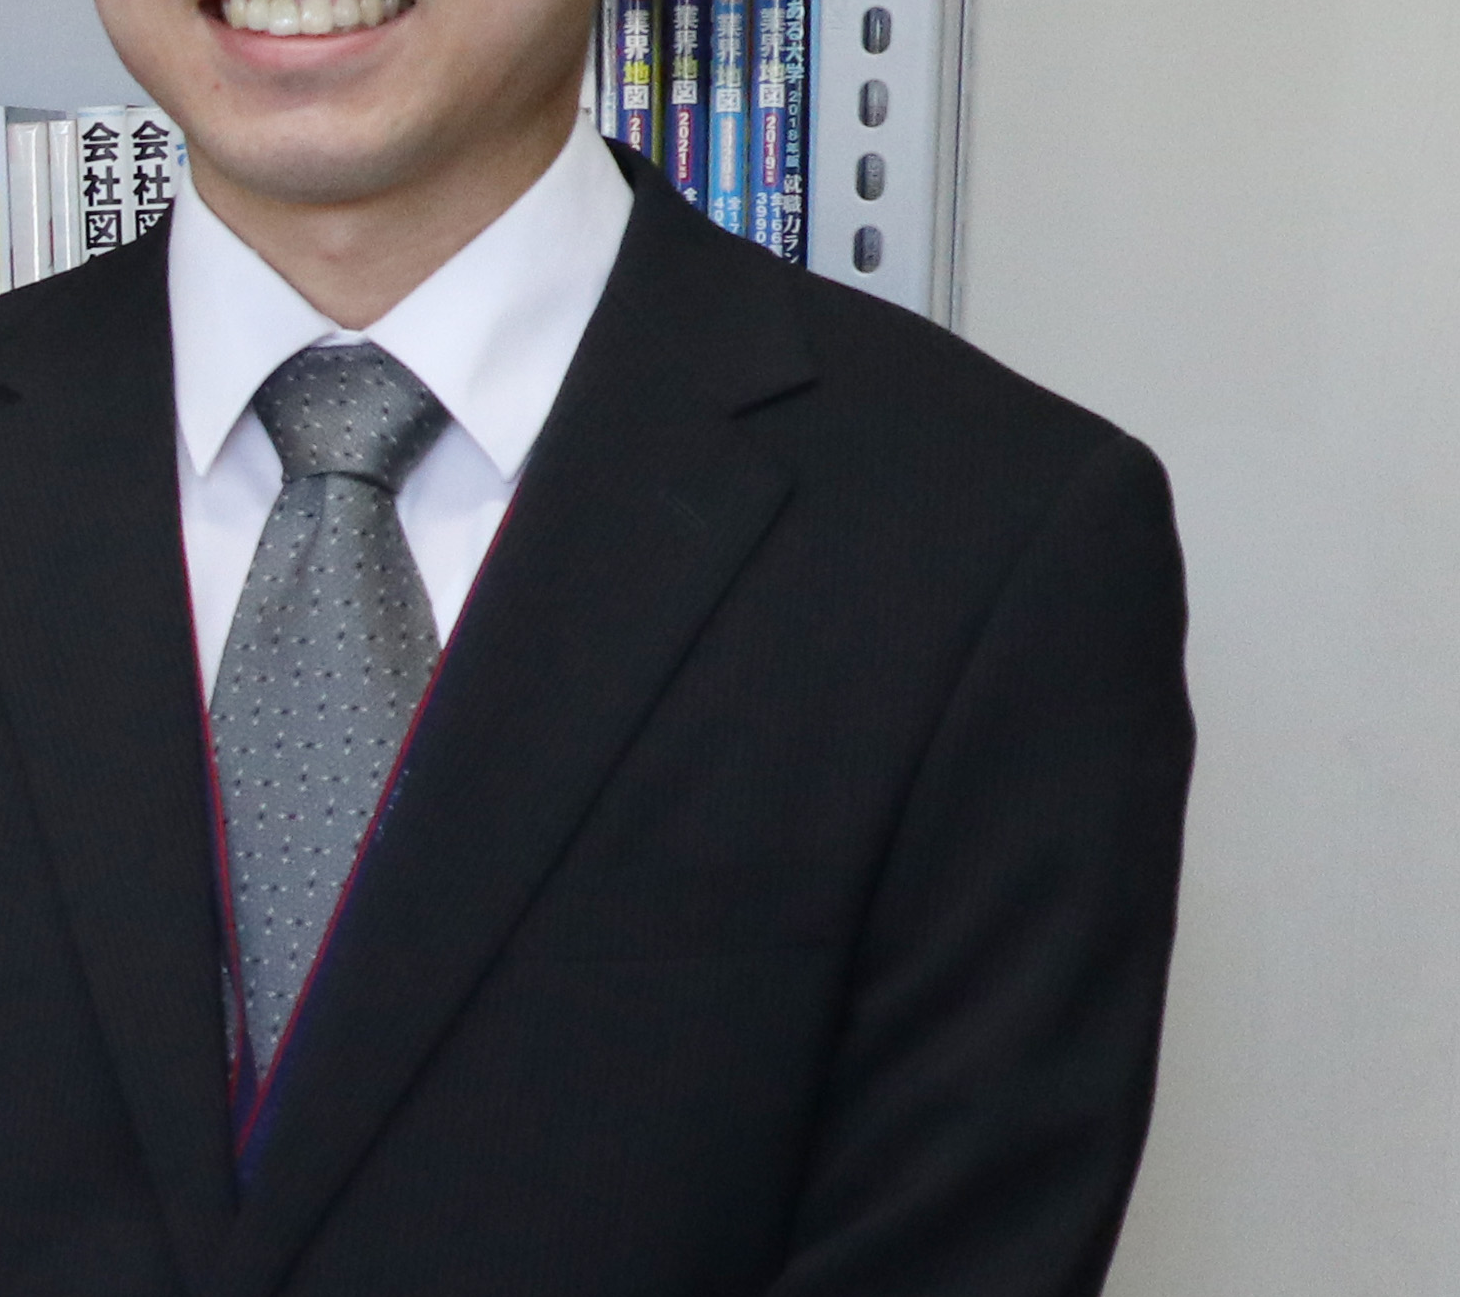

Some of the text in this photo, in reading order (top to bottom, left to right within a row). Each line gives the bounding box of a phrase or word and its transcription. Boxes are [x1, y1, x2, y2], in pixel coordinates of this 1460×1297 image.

[623, 10, 650, 110] 業界地図
[671, 5, 700, 106] 業界地図
[716, 13, 742, 113] 業界地図
[758, 7, 787, 110] 業界地図
